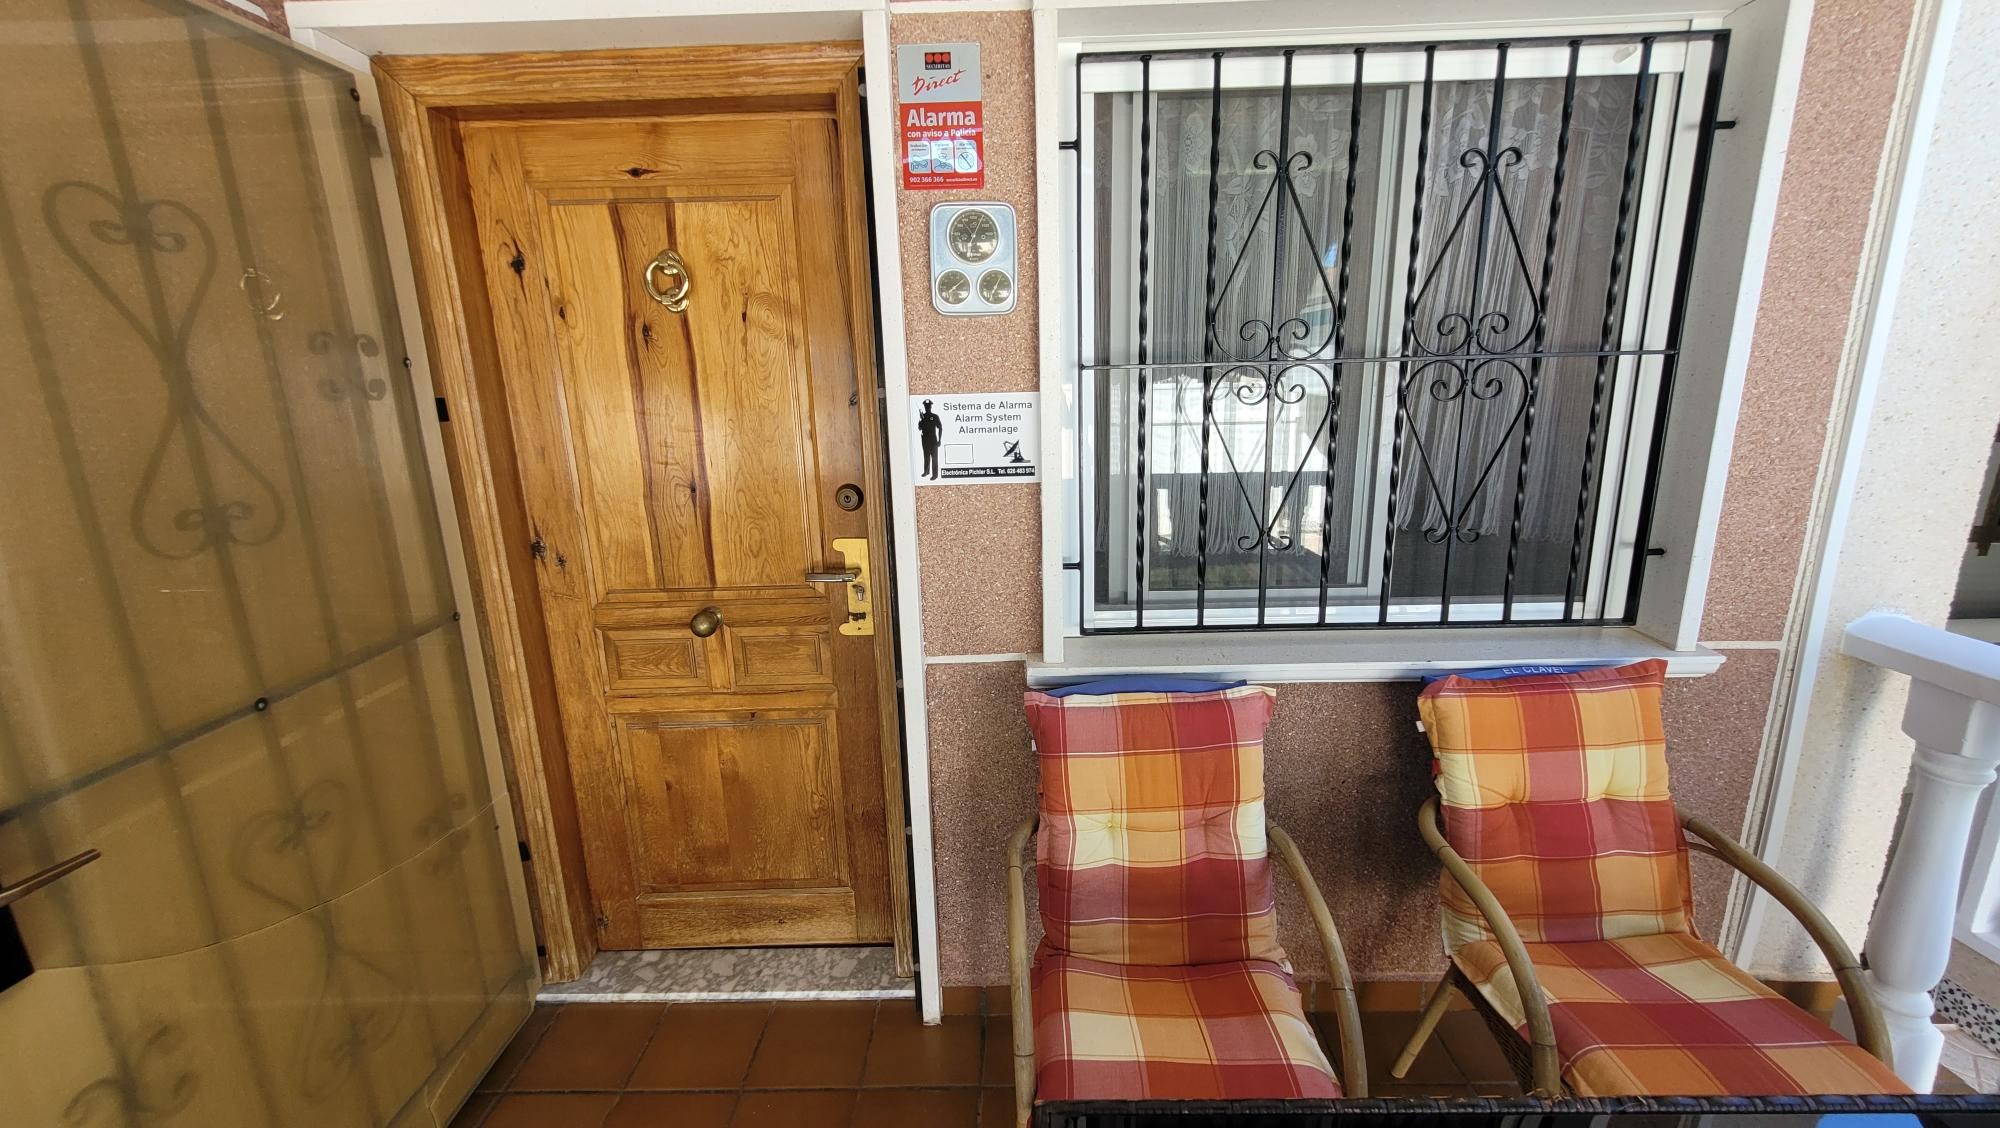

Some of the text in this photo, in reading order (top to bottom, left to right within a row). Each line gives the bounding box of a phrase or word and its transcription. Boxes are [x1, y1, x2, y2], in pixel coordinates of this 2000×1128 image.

[912, 69, 967, 95] Direct
[907, 107, 976, 127] Alarma
[922, 129, 942, 137] aviso
[943, 401, 1032, 411] Sistema de Alarma
[955, 413, 1021, 423] Alarm System
[958, 425, 1018, 434] Alarmanlage
[1522, 666, 1568, 674] CLAVEL
